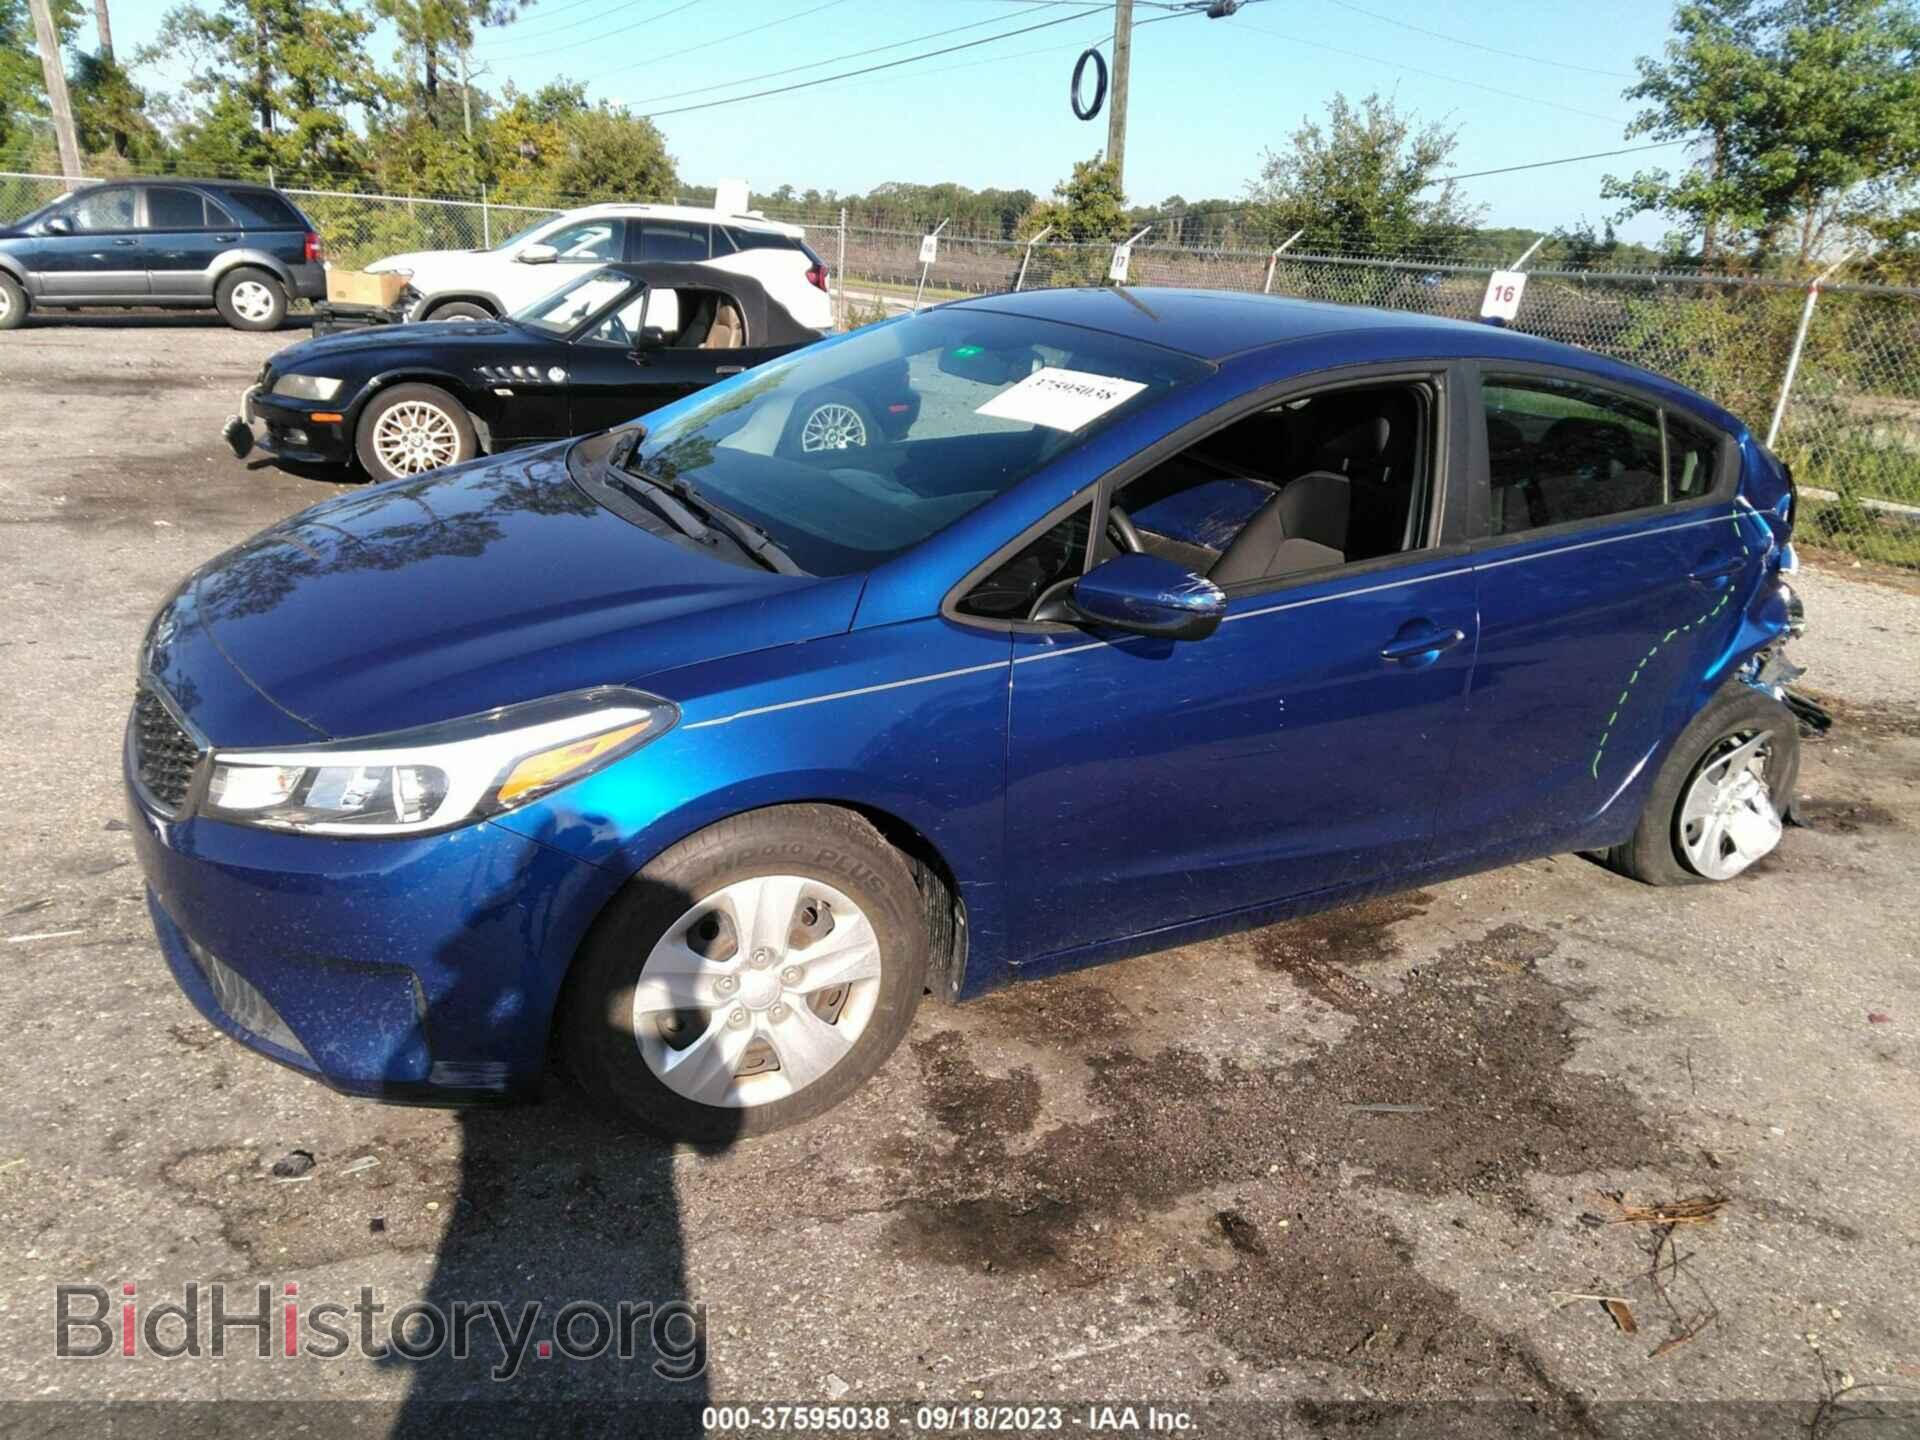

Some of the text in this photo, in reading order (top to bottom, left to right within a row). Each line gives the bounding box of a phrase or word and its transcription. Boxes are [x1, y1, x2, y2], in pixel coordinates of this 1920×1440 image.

[1115, 255, 1126, 267] 17
[1495, 285, 1515, 302] 16
[814, 847, 886, 892] PLUS
